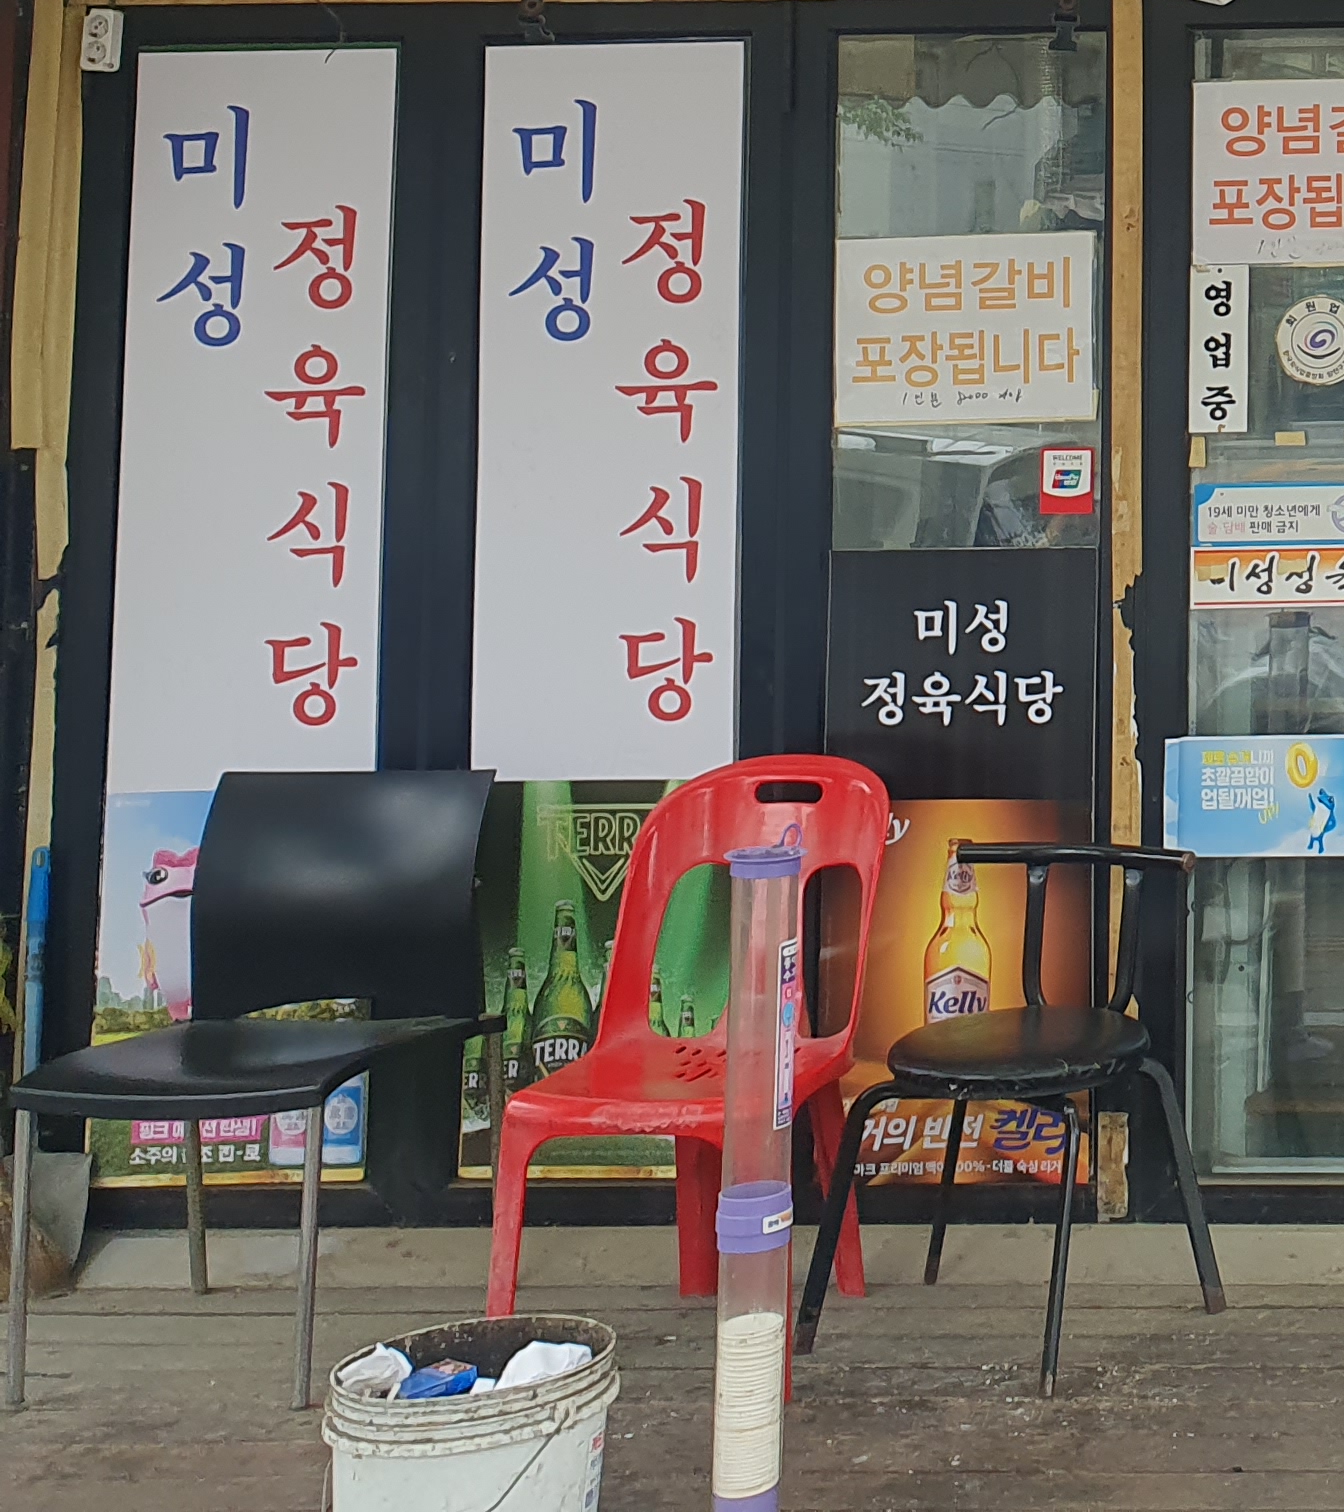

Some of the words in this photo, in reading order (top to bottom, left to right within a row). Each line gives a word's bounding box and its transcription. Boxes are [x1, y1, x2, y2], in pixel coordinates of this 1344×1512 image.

[157, 105, 250, 347] 미성
[508, 99, 597, 341] 미성
[863, 257, 1073, 314] 양념갈비
[853, 327, 1080, 388] 포장됩니다
[1203, 281, 1236, 423] 영업중
[264, 204, 365, 726] 정육식당
[614, 199, 718, 722] 정육식당
[1207, 505, 1232, 518] 19세
[1236, 504, 1259, 518] 미만
[1263, 503, 1321, 518] 청소년에게
[1249, 520, 1272, 534] 판매
[1276, 520, 1299, 534] 금지
[914, 600, 1010, 655] 미성
[861, 670, 1063, 727] 정육식당
[537, 804, 641, 862] TERR
[129, 1145, 178, 1165] 소주의
[139, 1121, 168, 1139] 핑크
